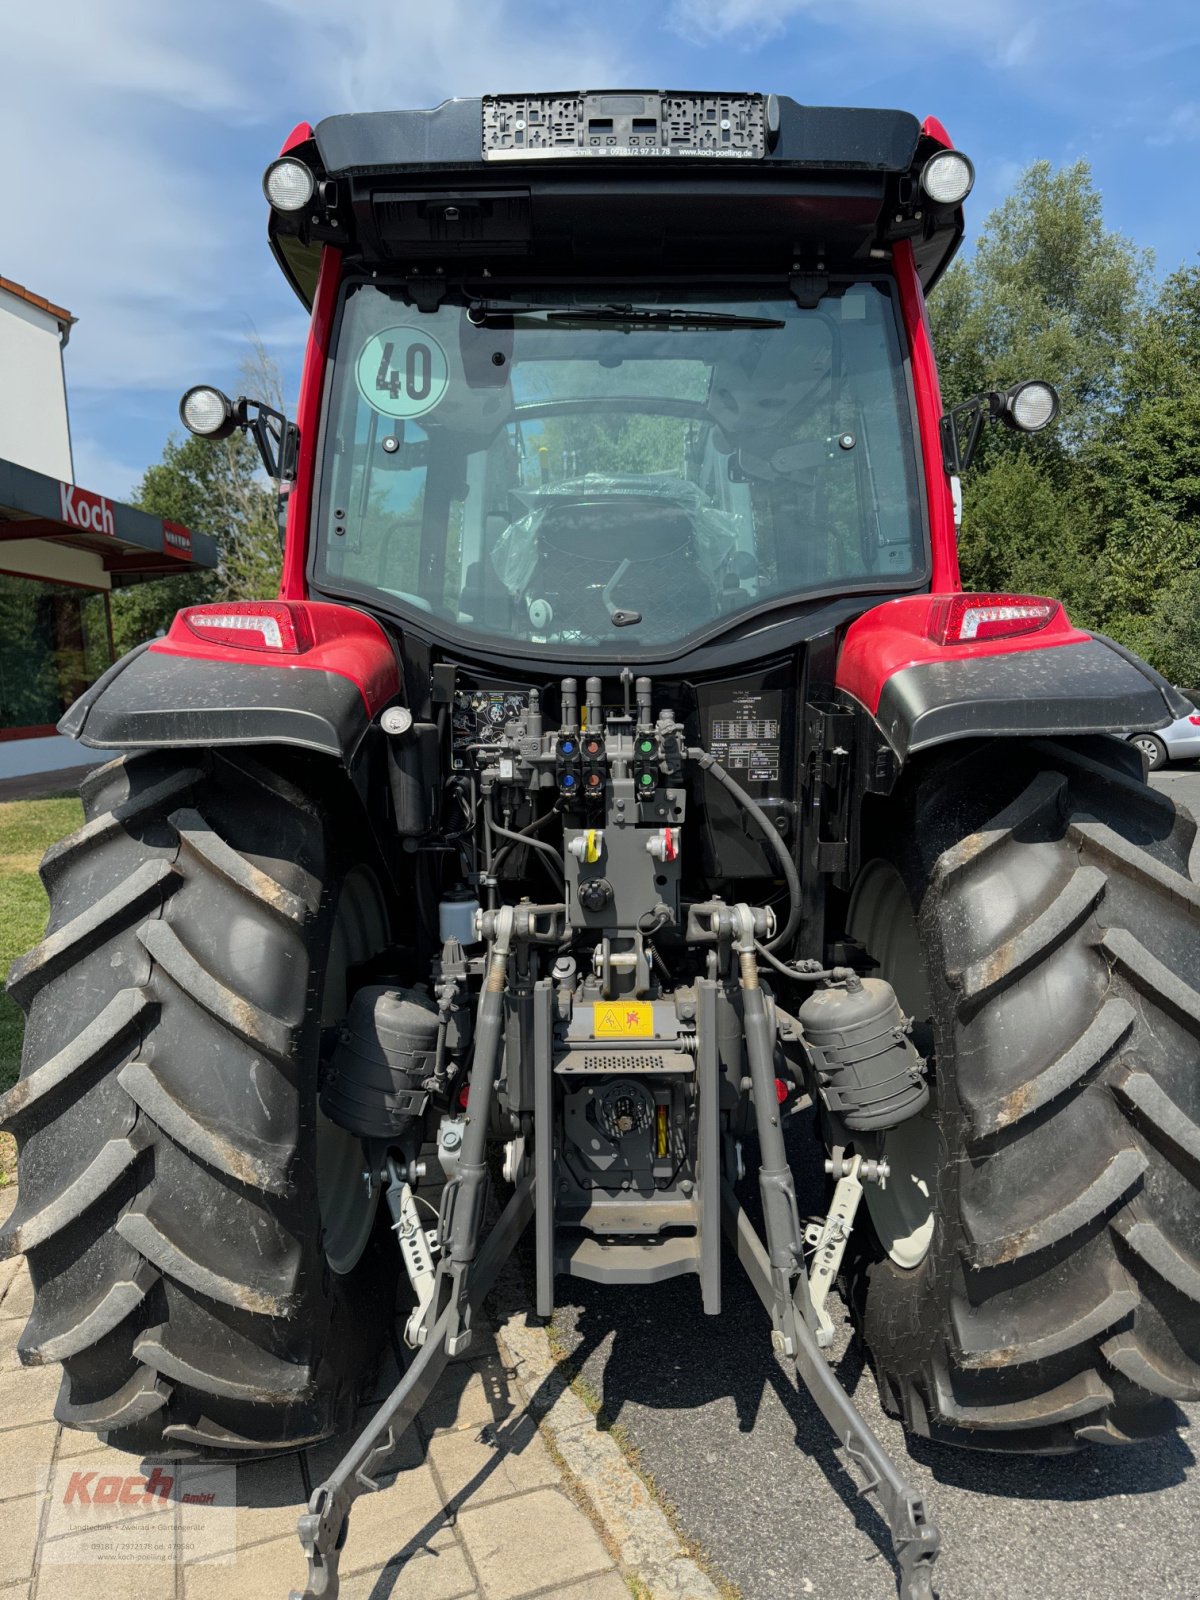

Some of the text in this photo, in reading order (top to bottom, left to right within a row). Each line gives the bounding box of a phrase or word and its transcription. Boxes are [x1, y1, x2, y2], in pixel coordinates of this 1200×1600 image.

[610, 147, 638, 156] 09181/2
[640, 147, 649, 155] 97
[651, 147, 660, 155] 21
[661, 147, 671, 155] 78
[679, 148, 752, 158] www.koch-poelling.de
[376, 342, 431, 400] 40
[60, 482, 114, 535] Koch
